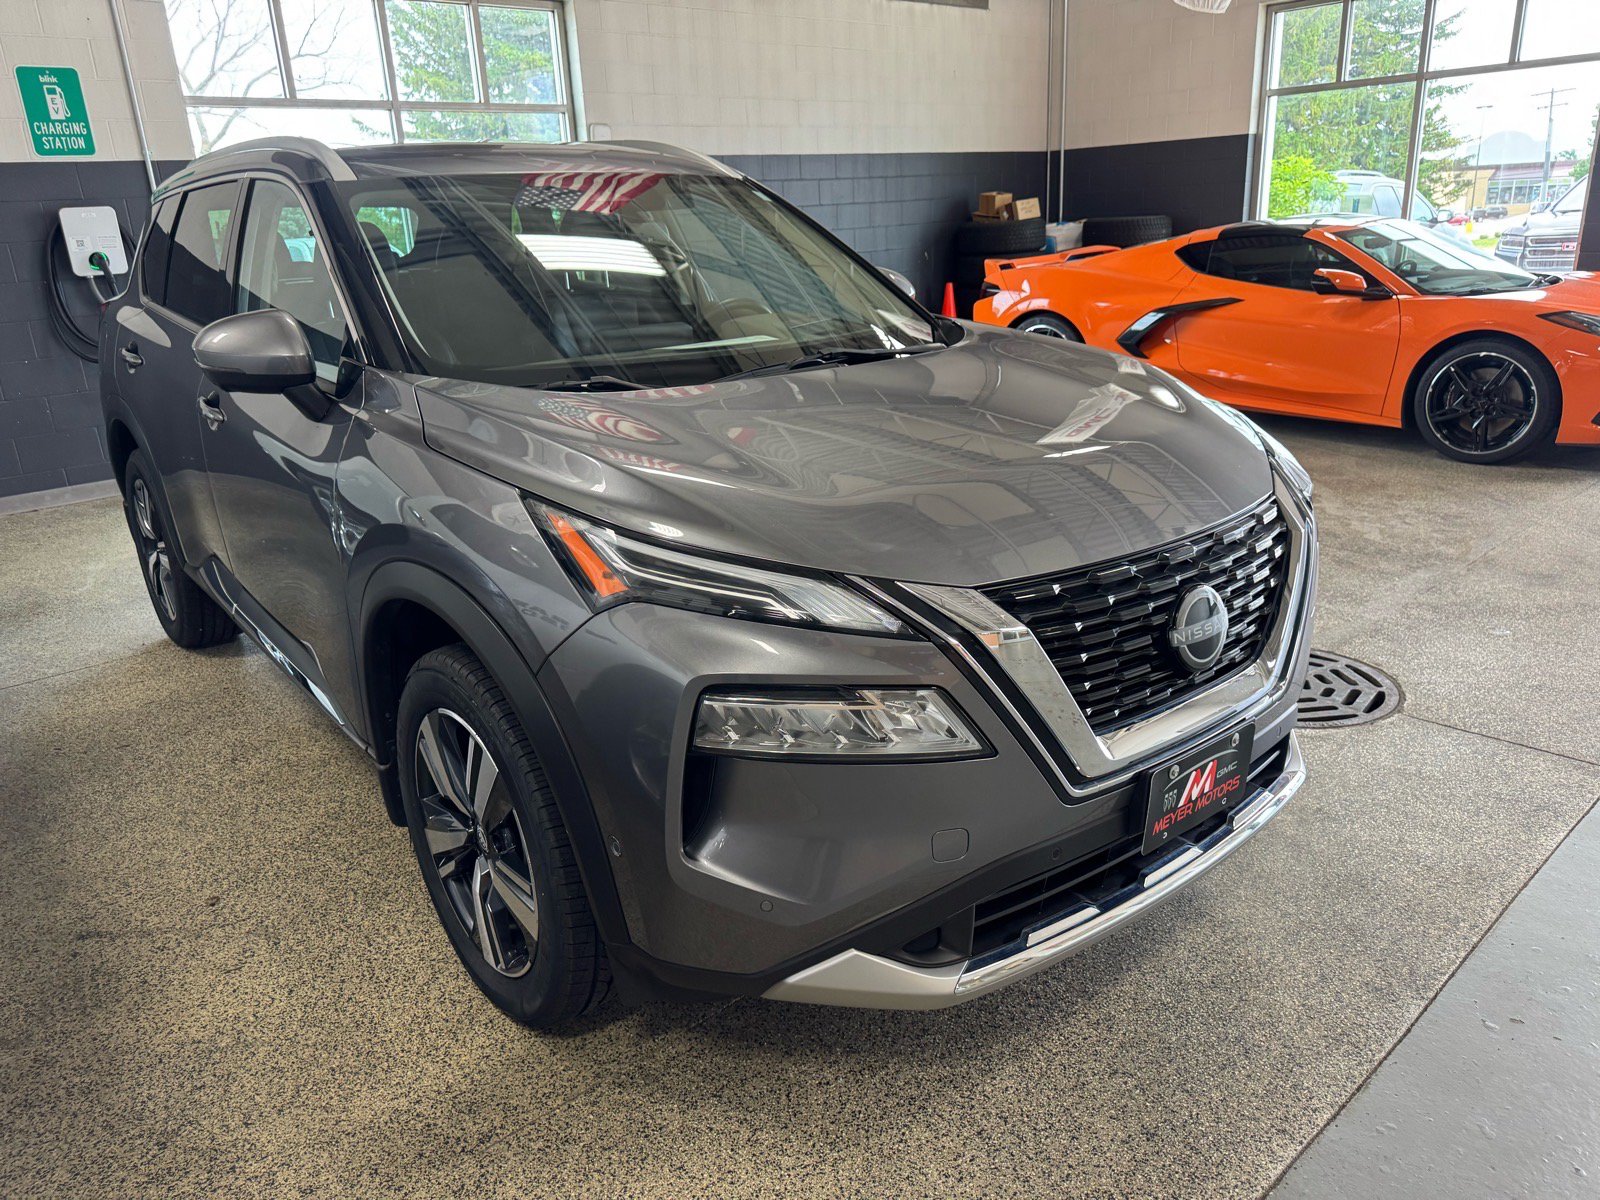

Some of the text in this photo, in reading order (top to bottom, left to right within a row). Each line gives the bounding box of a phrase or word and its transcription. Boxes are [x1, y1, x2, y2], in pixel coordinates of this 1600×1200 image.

[38, 72, 58, 83] blink
[33, 121, 88, 135] CHARGING
[42, 136, 86, 150] STATION
[1173, 619, 1224, 645] NISSA
[1216, 760, 1238, 778] GMC
[1152, 775, 1241, 836] MEYER MOTORS
